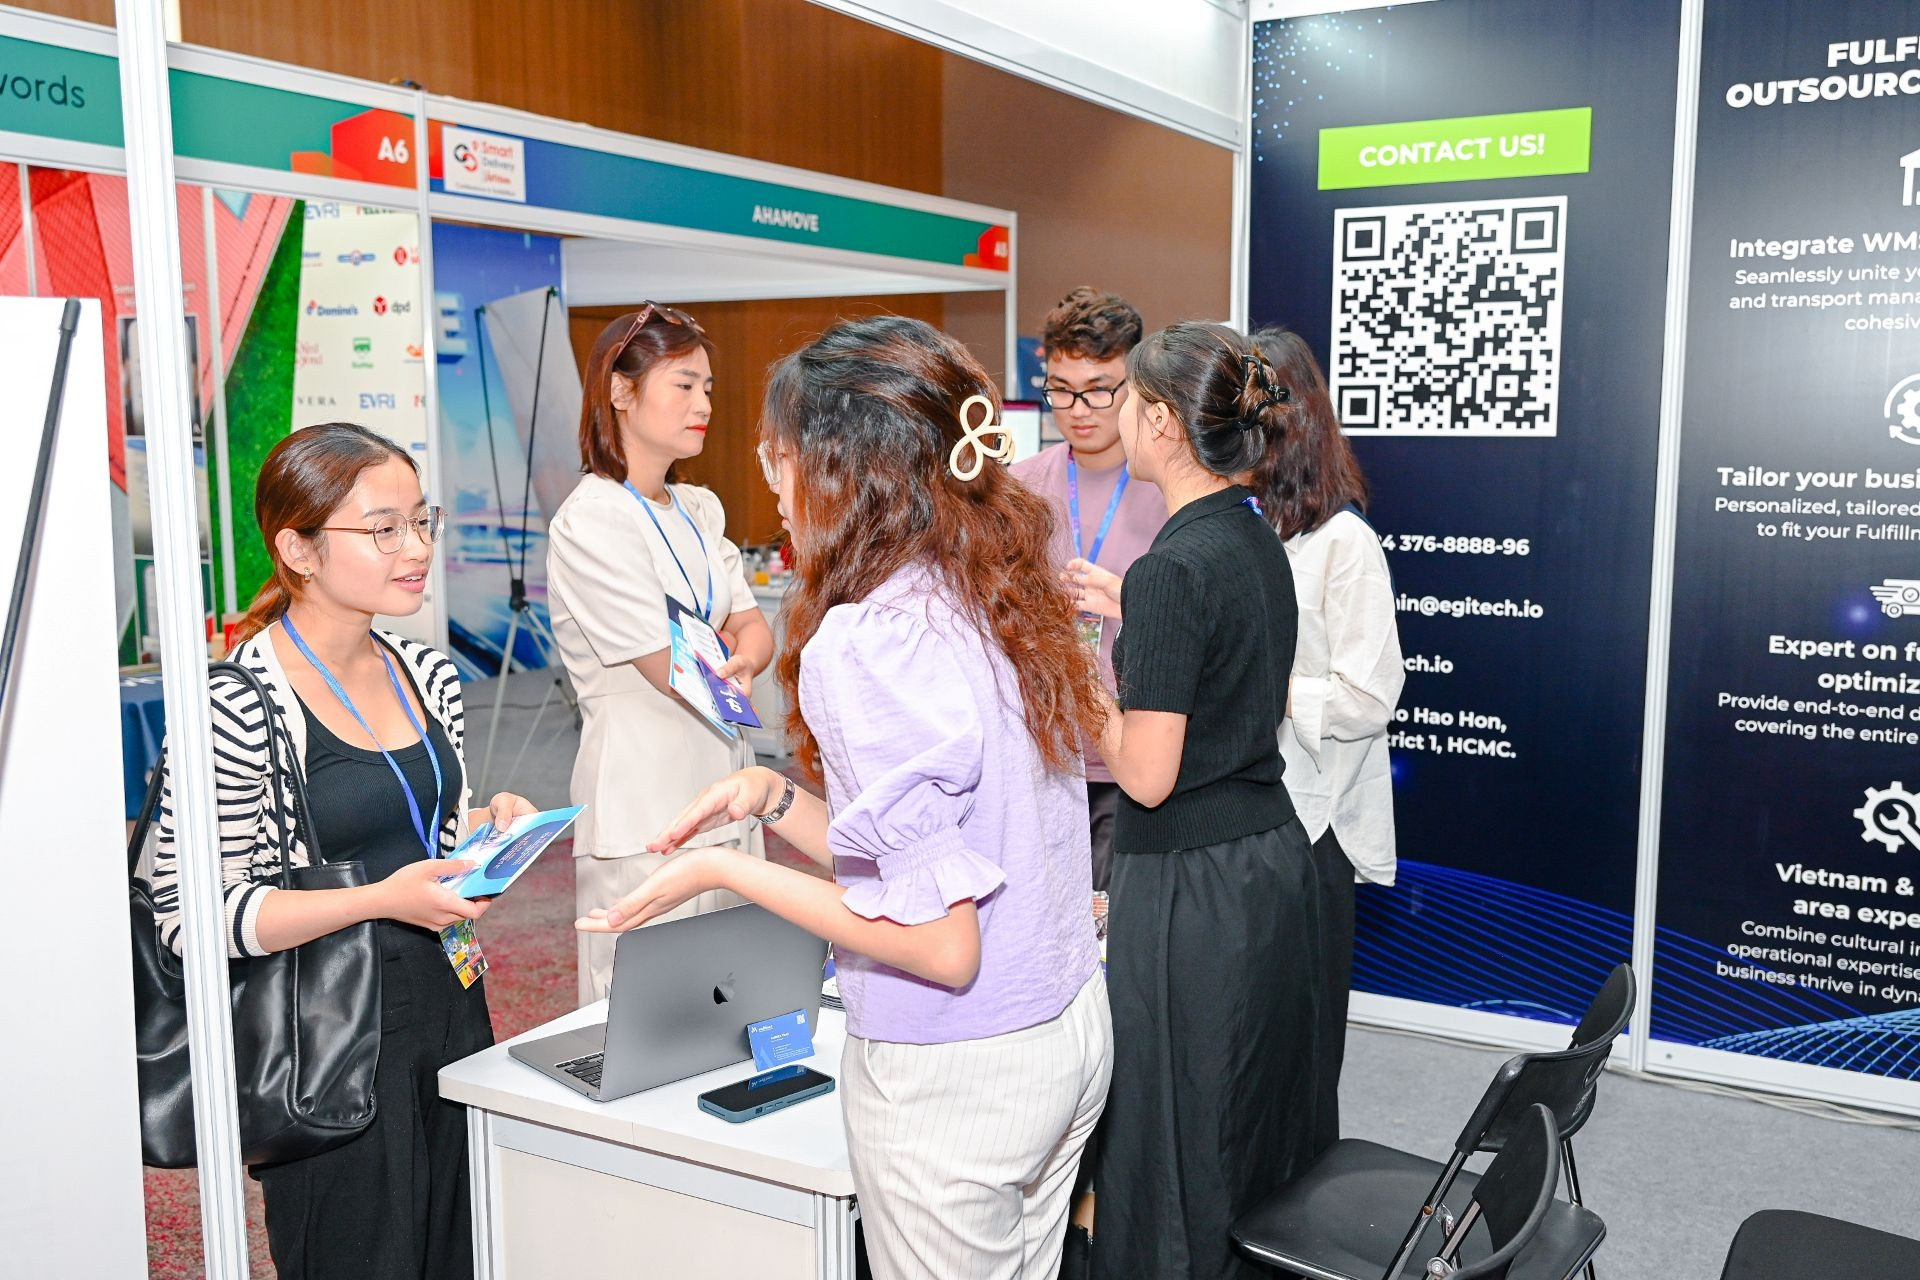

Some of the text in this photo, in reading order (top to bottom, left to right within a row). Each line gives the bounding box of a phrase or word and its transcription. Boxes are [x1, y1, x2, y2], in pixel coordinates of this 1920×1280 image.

[1827, 36, 1920, 67] FULF
[1725, 69, 1920, 108] OUTSOURC
[377, 135, 410, 165] A6
[1358, 134, 1546, 167] CONTACT US!
[752, 204, 820, 233] AHAMOVE
[1729, 231, 1920, 260] Integrate WM
[1735, 264, 1920, 285] Seamlessly unite y
[391, 301, 411, 315] dpd
[1729, 293, 1767, 309] and
[1771, 291, 1862, 310] transport
[1844, 313, 1920, 331] cohesiv
[1716, 466, 1920, 492] Tailor your busi
[1715, 496, 1920, 518] Personalized, tailored
[1757, 522, 1777, 538] to
[1781, 521, 1801, 538] fit
[1805, 524, 1850, 541] your
[1379, 534, 1531, 556] 4 376-8888-96
[1769, 634, 1855, 660] Expert
[1862, 643, 1897, 661] on
[1402, 654, 1454, 674] ch.io
[1818, 670, 1920, 694] optimiz
[1718, 692, 1789, 712] Provide
[1793, 697, 1904, 720] end-to-end
[1391, 706, 1508, 734] o Hao Hon,
[1735, 718, 1918, 745] covering the entire
[1429, 734, 1443, 755] 1,
[1447, 736, 1518, 759] HCMC.
[1776, 862, 1914, 896] Vietnam &
[1793, 899, 1920, 930] area expe
[1741, 920, 1827, 944] Combine
[1831, 934, 1904, 955] cultural
[1727, 943, 1832, 968] operational
[1716, 961, 1795, 986] business
[1800, 973, 1854, 994] thrive
[1859, 980, 1876, 998] in
